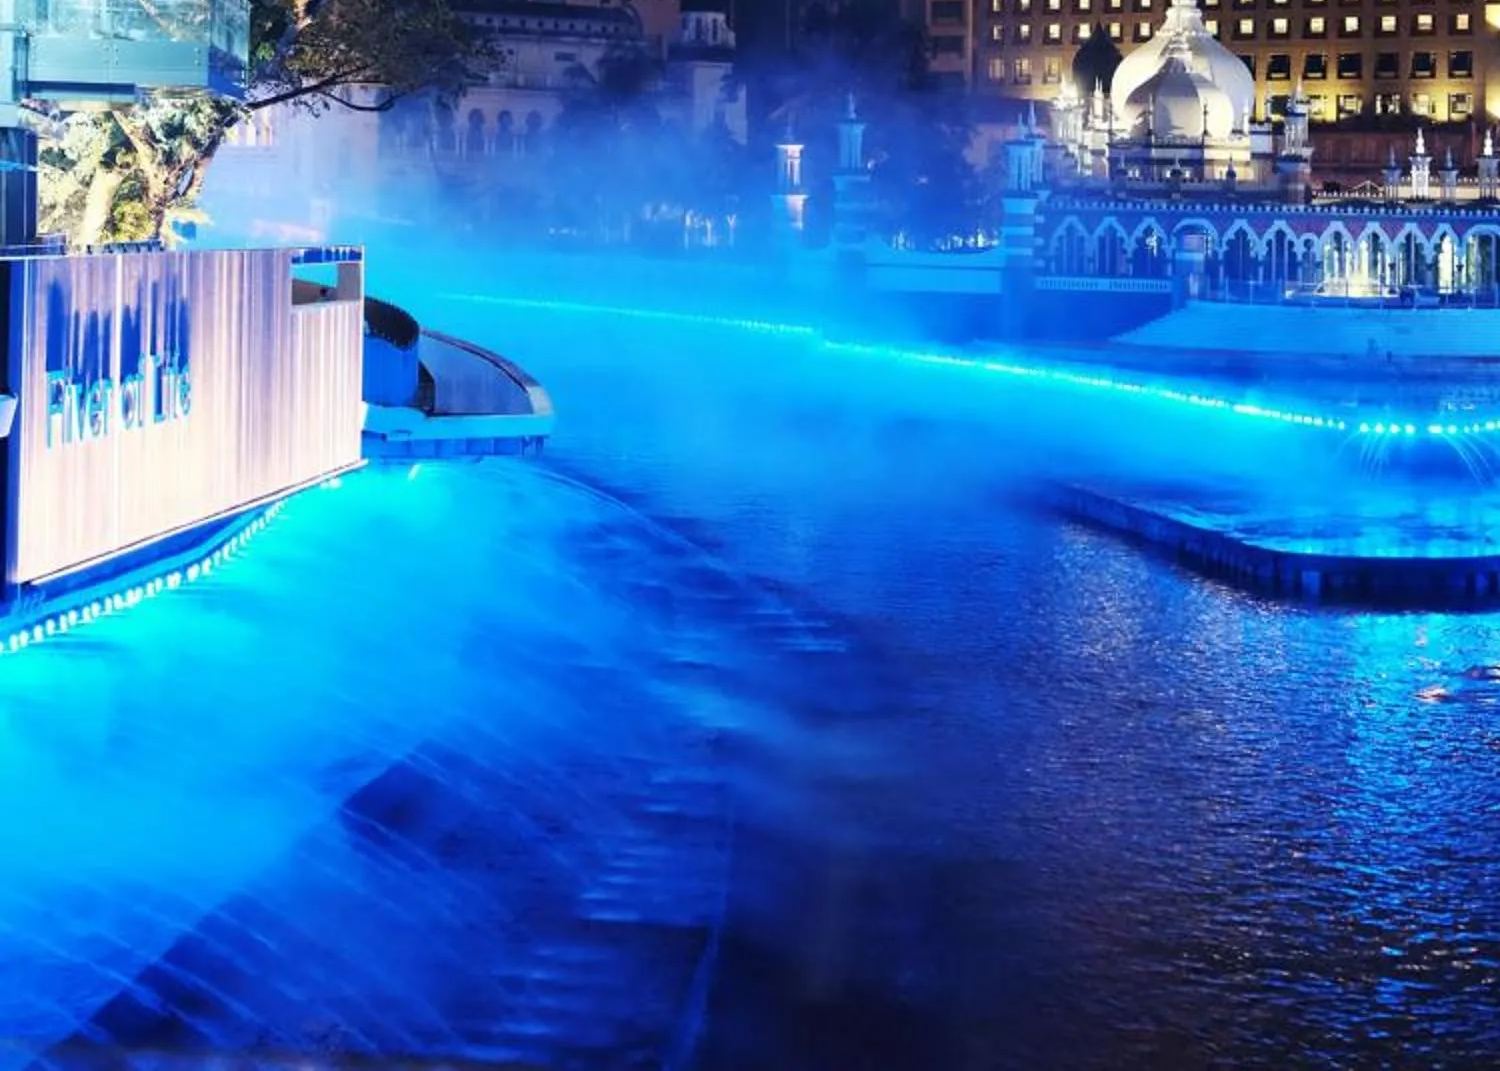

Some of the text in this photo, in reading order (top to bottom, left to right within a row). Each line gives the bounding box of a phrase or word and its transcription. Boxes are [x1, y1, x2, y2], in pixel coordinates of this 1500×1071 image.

[45, 353, 192, 449] River of Life
